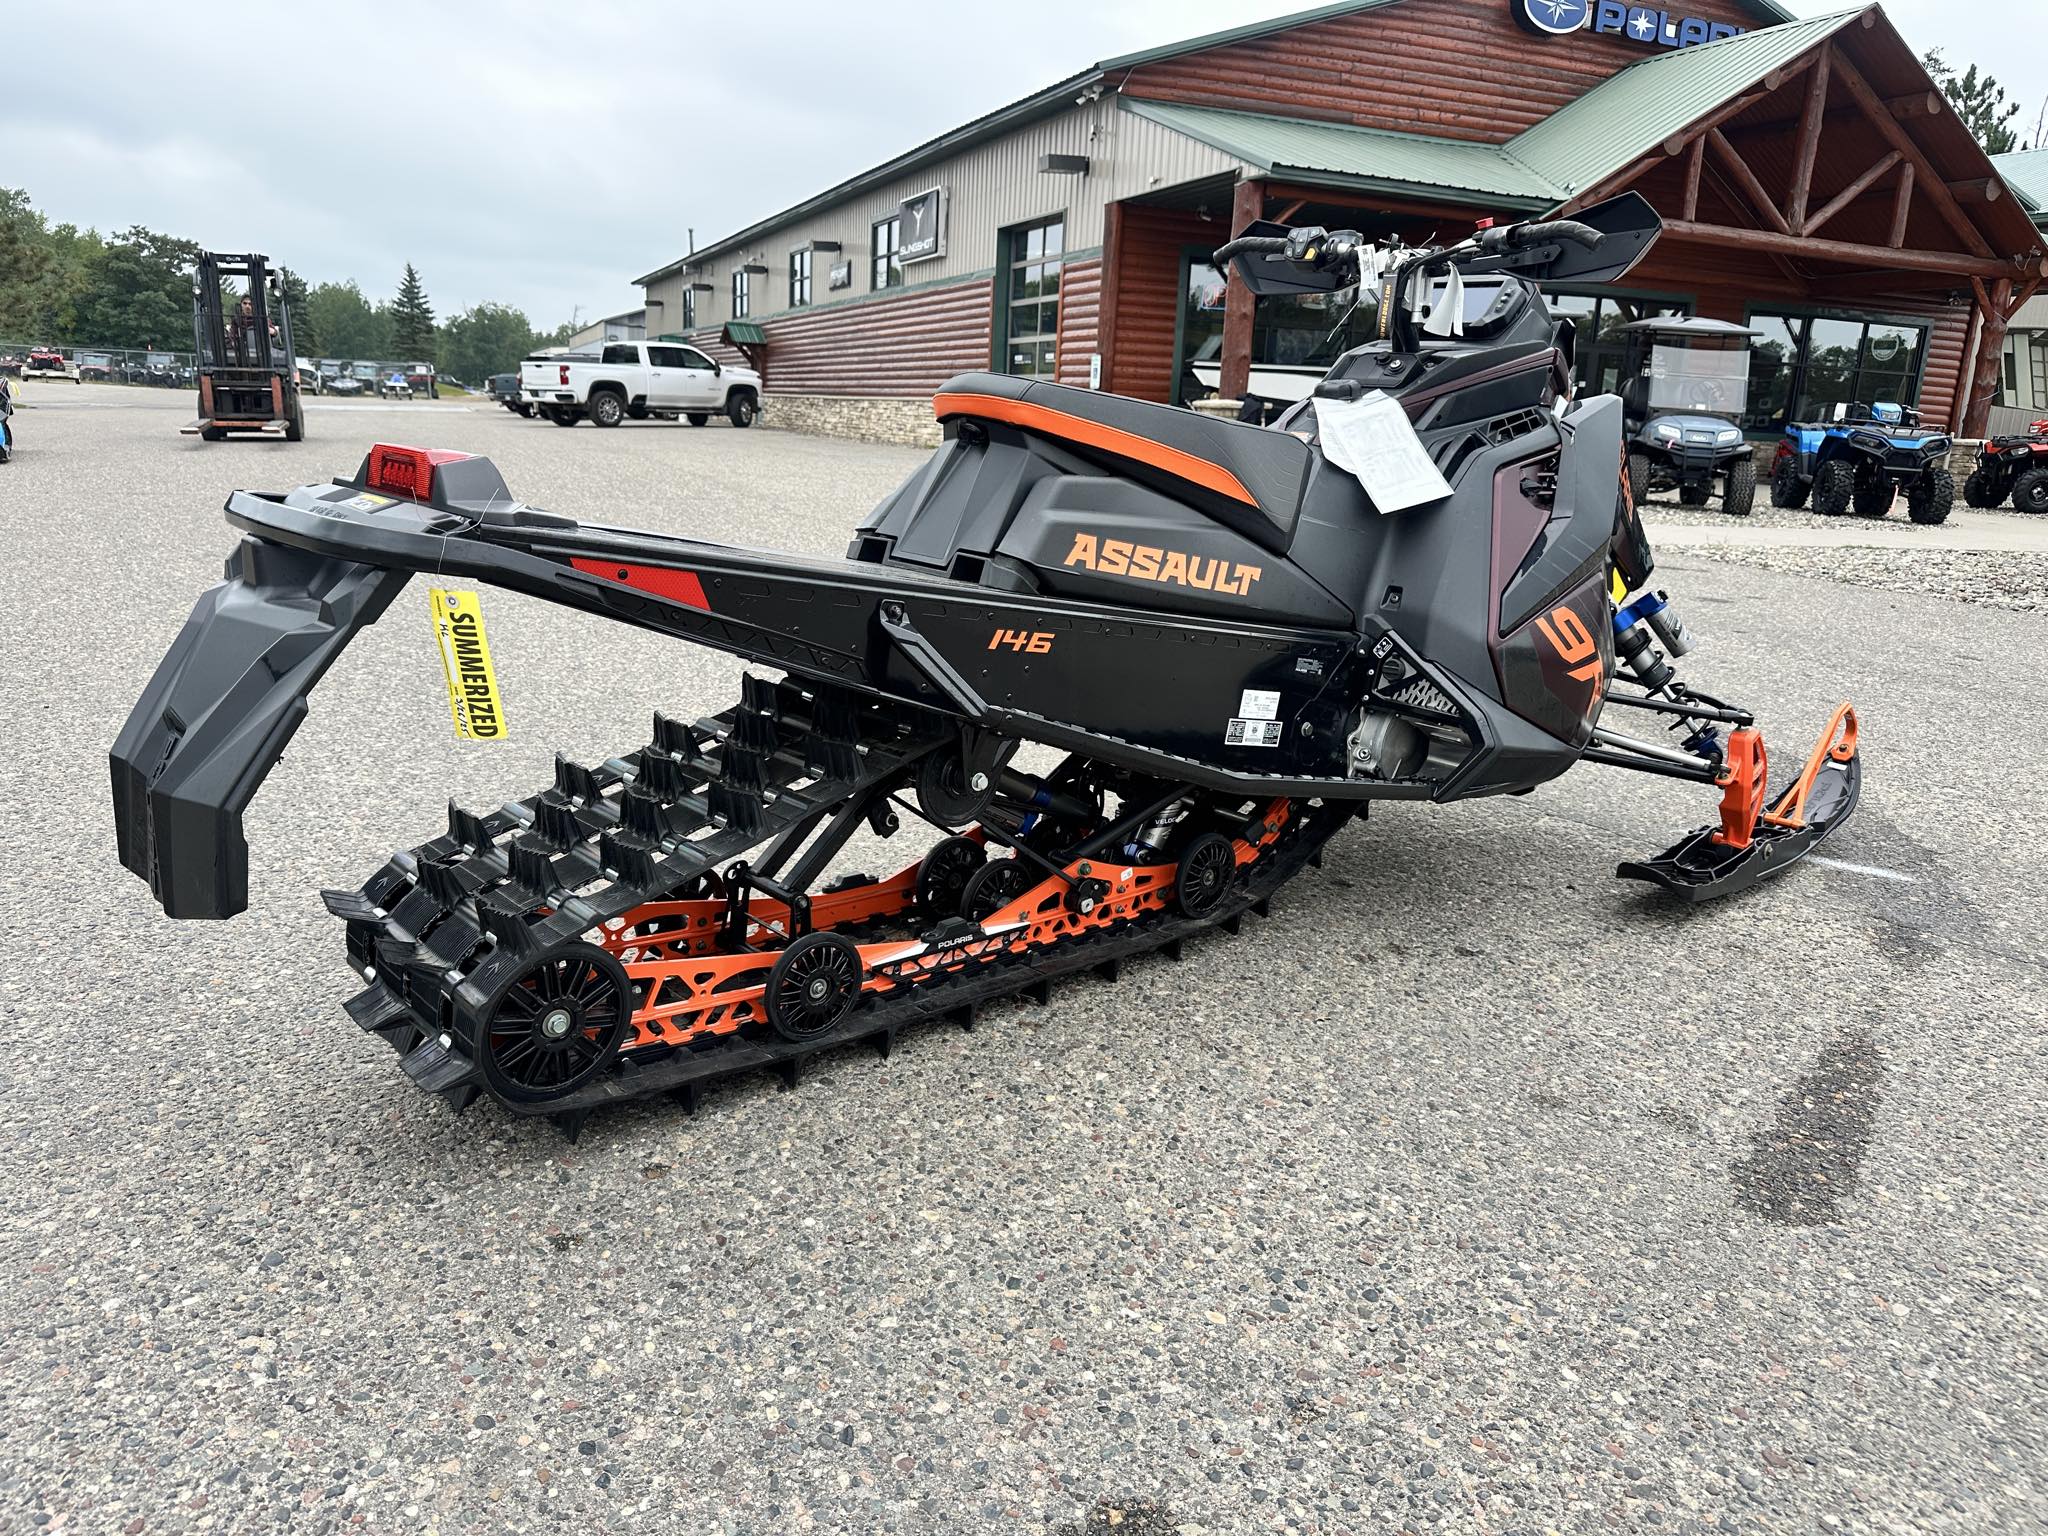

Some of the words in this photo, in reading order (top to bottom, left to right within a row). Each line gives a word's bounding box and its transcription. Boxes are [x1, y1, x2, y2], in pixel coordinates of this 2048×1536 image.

[1596, 1, 1746, 48] POLAR
[1064, 533, 1262, 596] ASSAULT
[987, 629, 1056, 654] 146
[449, 611, 499, 738] SUMMERIZED
[938, 934, 974, 949] POLARIS
